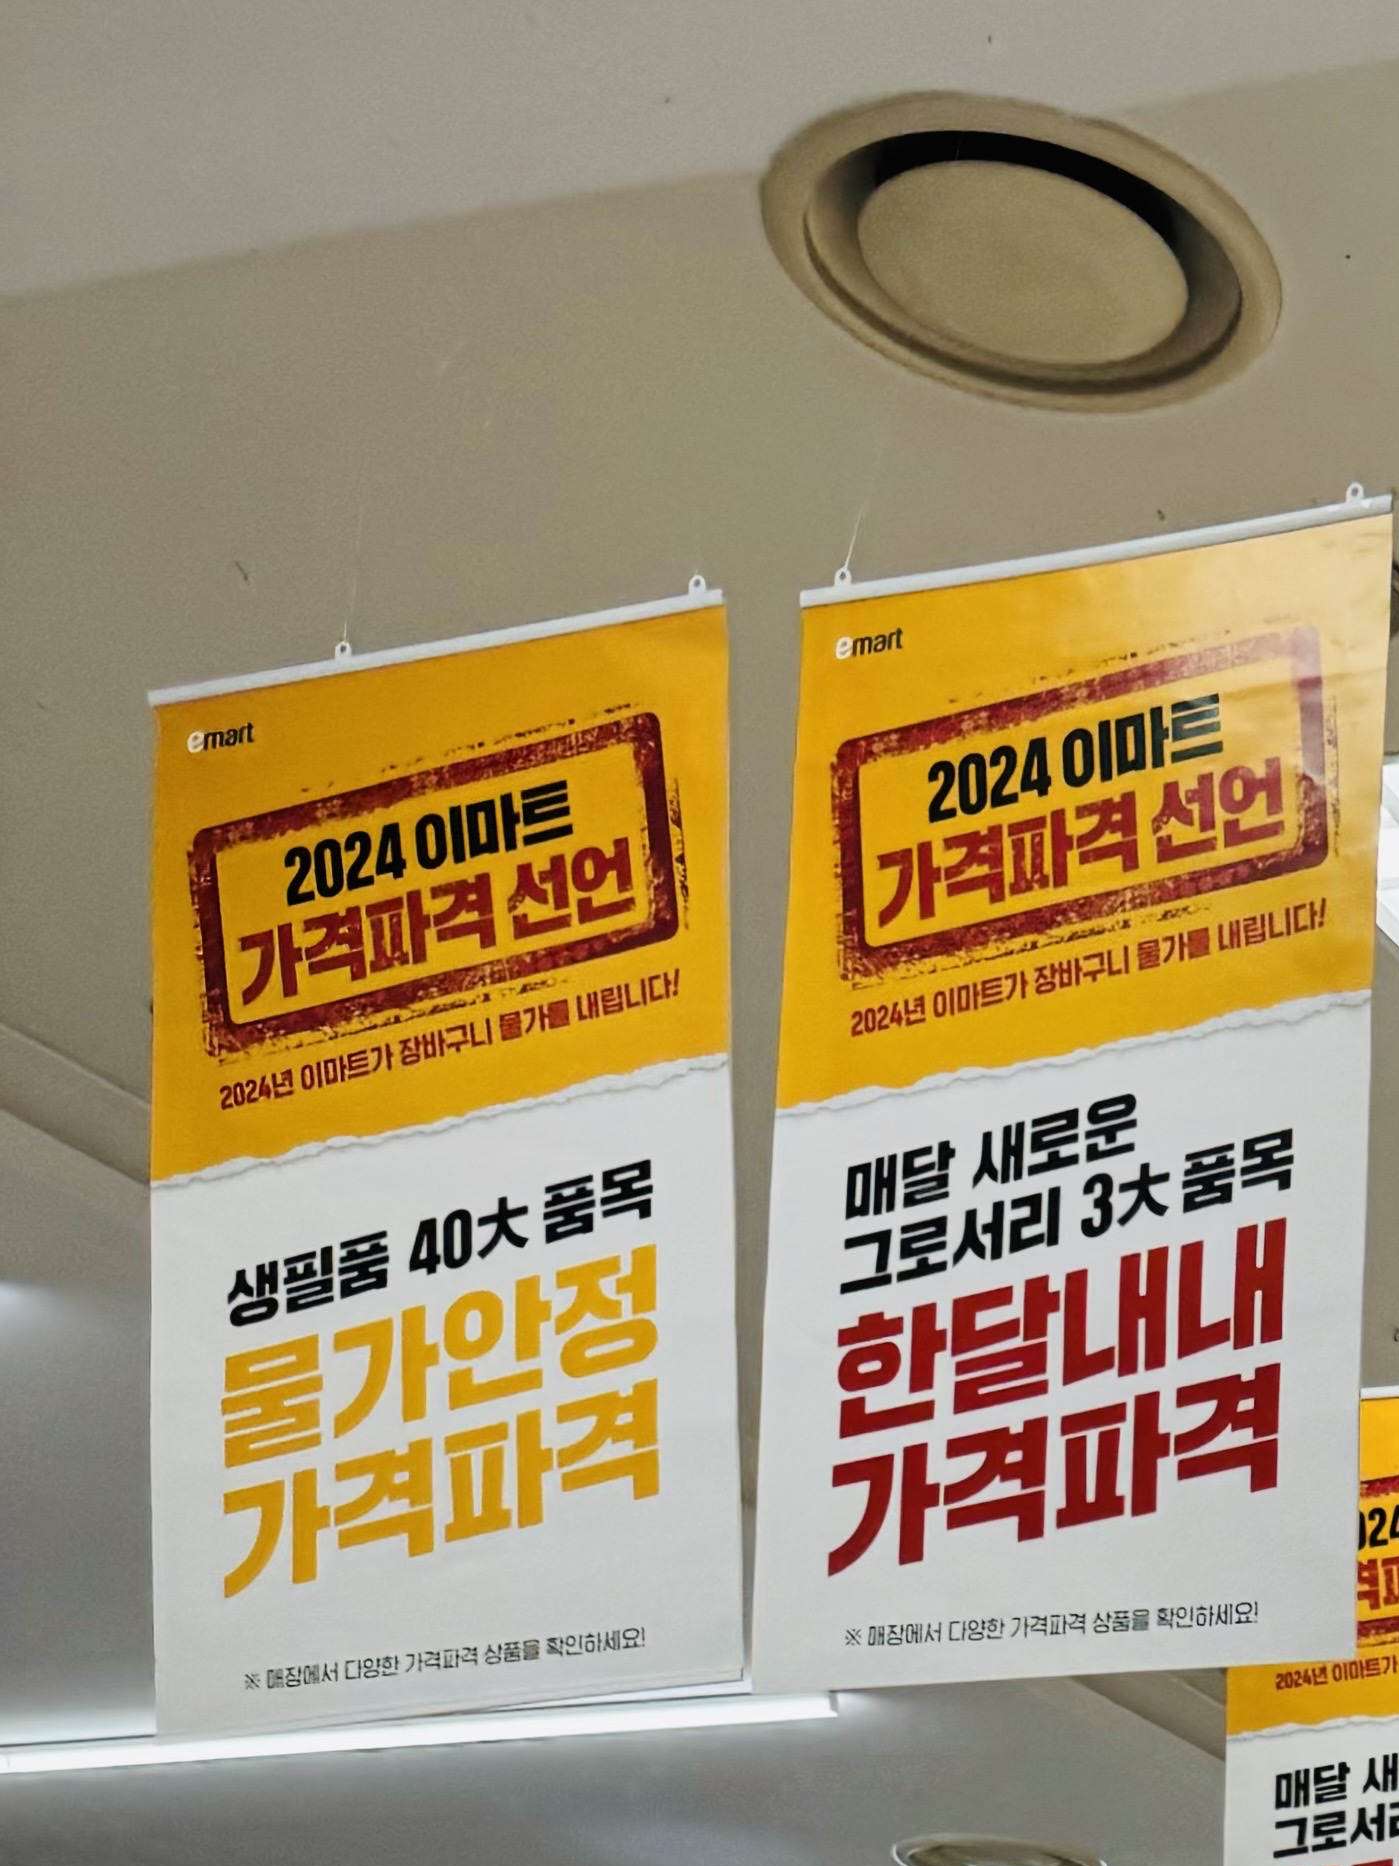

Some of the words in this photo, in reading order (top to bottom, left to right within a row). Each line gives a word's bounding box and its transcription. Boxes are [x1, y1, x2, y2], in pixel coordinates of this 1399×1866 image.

[836, 627, 903, 660] emart
[188, 721, 254, 753] emart
[927, 737, 1051, 823] 2024
[1063, 692, 1223, 787] 이마트
[284, 824, 407, 905] 2024
[415, 780, 573, 870] 이마트
[877, 790, 1139, 928] 가격파격
[1151, 756, 1285, 865] 선언
[239, 872, 497, 1006] 가격파격
[509, 837, 635, 940] 선언
[851, 998, 925, 1037] 2024년
[933, 970, 1028, 1017] 이마트가
[1034, 944, 1129, 993] 장바구니
[1137, 927, 1210, 970] 물가를
[1218, 897, 1326, 950] 내립니다!
[219, 1070, 293, 1110] 2024년
[301, 1045, 393, 1093] 이마트가
[399, 1017, 493, 1067] 장바구니
[500, 999, 570, 1041] 물가를
[577, 969, 681, 1021] 내립니다!
[840, 1187, 1061, 1295] 그로서리
[1080, 1162, 1170, 1238] 3大
[1182, 1128, 1294, 1214] 품목
[845, 1140, 955, 1220] 매달
[972, 1093, 1137, 1189] 새로운
[228, 1230, 390, 1327] 생필품
[409, 1196, 529, 1276] 40大
[543, 1159, 653, 1244] 품목
[221, 1243, 658, 1468] 물가안정
[837, 1216, 1287, 1439] 한달내내
[224, 1378, 659, 1599] 가격파격
[827, 1362, 1281, 1577] 가격파격
[267, 1663, 339, 1691] 매장에서
[345, 1656, 399, 1680] 다양한
[405, 1646, 479, 1674] 가격파격
[485, 1639, 540, 1666] 상품을
[547, 1627, 645, 1658] 확인하세요!
[868, 1621, 942, 1647] 매장에서
[948, 1614, 1005, 1643] 다양한
[1010, 1612, 1087, 1638] 가격파격
[1092, 1609, 1149, 1635] 상품을
[1157, 1600, 1258, 1629] 확인하세요!
[1276, 1668, 1328, 1690] 2024년
[1333, 1658, 1398, 1683] 이마트가
[1275, 1762, 1350, 1810] 매달
